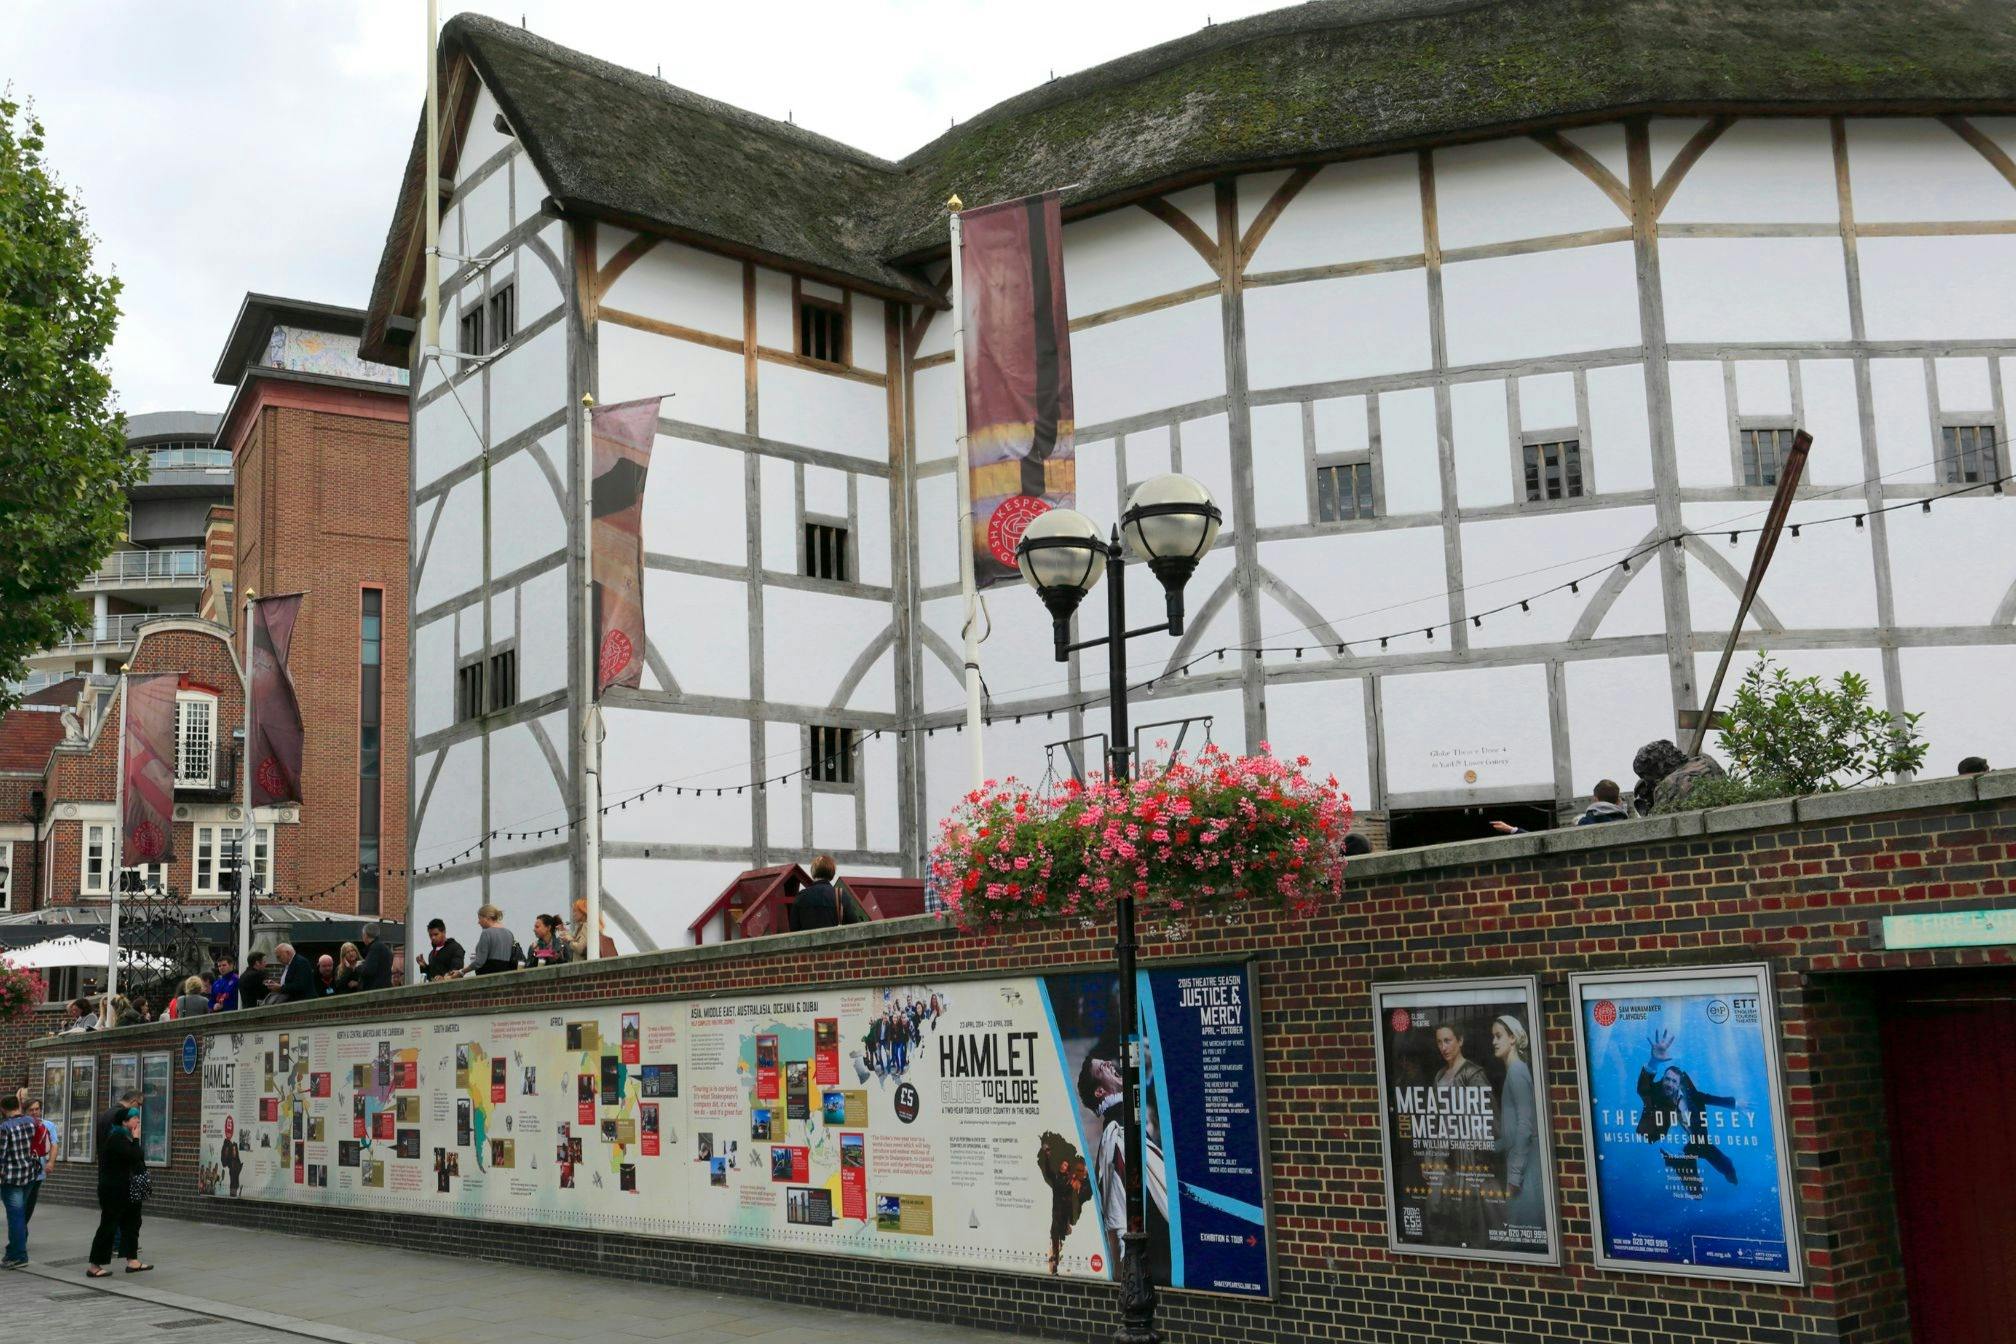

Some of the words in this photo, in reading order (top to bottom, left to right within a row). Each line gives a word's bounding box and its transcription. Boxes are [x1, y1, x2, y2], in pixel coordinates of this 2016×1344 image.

[1923, 916, 1964, 930] FIRE
[1192, 977, 1217, 987] THEATRE
[1218, 975, 1241, 986] SEASON
[1180, 986, 1228, 1007] JUSTICE
[1231, 985, 1241, 1004] &
[691, 1008, 702, 1019] ASIA,
[704, 1007, 722, 1018] MIDDLE
[723, 1006, 737, 1017] EAST,
[737, 1003, 772, 1016] AUSTRALASIA,
[773, 1003, 795, 1015] OCEANIA
[797, 1002, 802, 1013] &
[802, 1001, 819, 1012] DUBAI
[1630, 1004, 1662, 1013] WANAMAKER
[1733, 999, 1757, 1009] ETT
[1200, 1005, 1241, 1025] MERCY
[1619, 1012, 1648, 1020] PLAYHOUSE
[433, 1024, 445, 1034] SOUTH
[445, 1023, 460, 1033] AMERICA
[965, 1021, 975, 1029] APRIL
[993, 1020, 1003, 1028] APRIL
[1202, 1027, 1216, 1035] APRIL
[1221, 1026, 1243, 1035] OCTOBER
[939, 1032, 1039, 1078] HAMLET
[203, 1064, 236, 1089] HAMLET
[221, 1089, 235, 1104] GLOBE
[900, 1086, 914, 1107] £5
[941, 1080, 981, 1104] GLOBE
[981, 1080, 994, 1098] TO
[994, 1079, 1039, 1104] GLOBE
[1395, 1086, 1494, 1114] MEASURE
[963, 1106, 974, 1115] TOUR
[974, 1106, 980, 1115] TO
[980, 1106, 993, 1115] EVERY
[993, 1106, 1011, 1115] COUNTRY
[1016, 1106, 1025, 1115] THE
[1025, 1106, 1040, 1115] WORLD
[1602, 1110, 1639, 1127] THE
[1655, 1110, 1755, 1128] ODYSSEY
[1399, 1115, 1411, 1139] FOR
[1411, 1115, 1495, 1139] MEASURE
[1413, 1140, 1421, 1149] BY
[1423, 1140, 1450, 1150] WILLIAM
[1450, 1141, 1496, 1151] SHAKESPEARE
[1604, 1132, 1654, 1145] MISSING,
[1660, 1133, 1721, 1146] PRESUMED
[1727, 1135, 1759, 1146] DEAD
[1404, 1215, 1416, 1228] £5
[1200, 1233, 1225, 1242] EXHIBITION
[1231, 1235, 1243, 1244] TOUR
[1508, 1229, 1520, 1238] 020
[1520, 1229, 1533, 1239] 7401
[1533, 1230, 1547, 1239] 9919
[1632, 1237, 1644, 1246] 020
[1644, 1238, 1655, 1247] 7401
